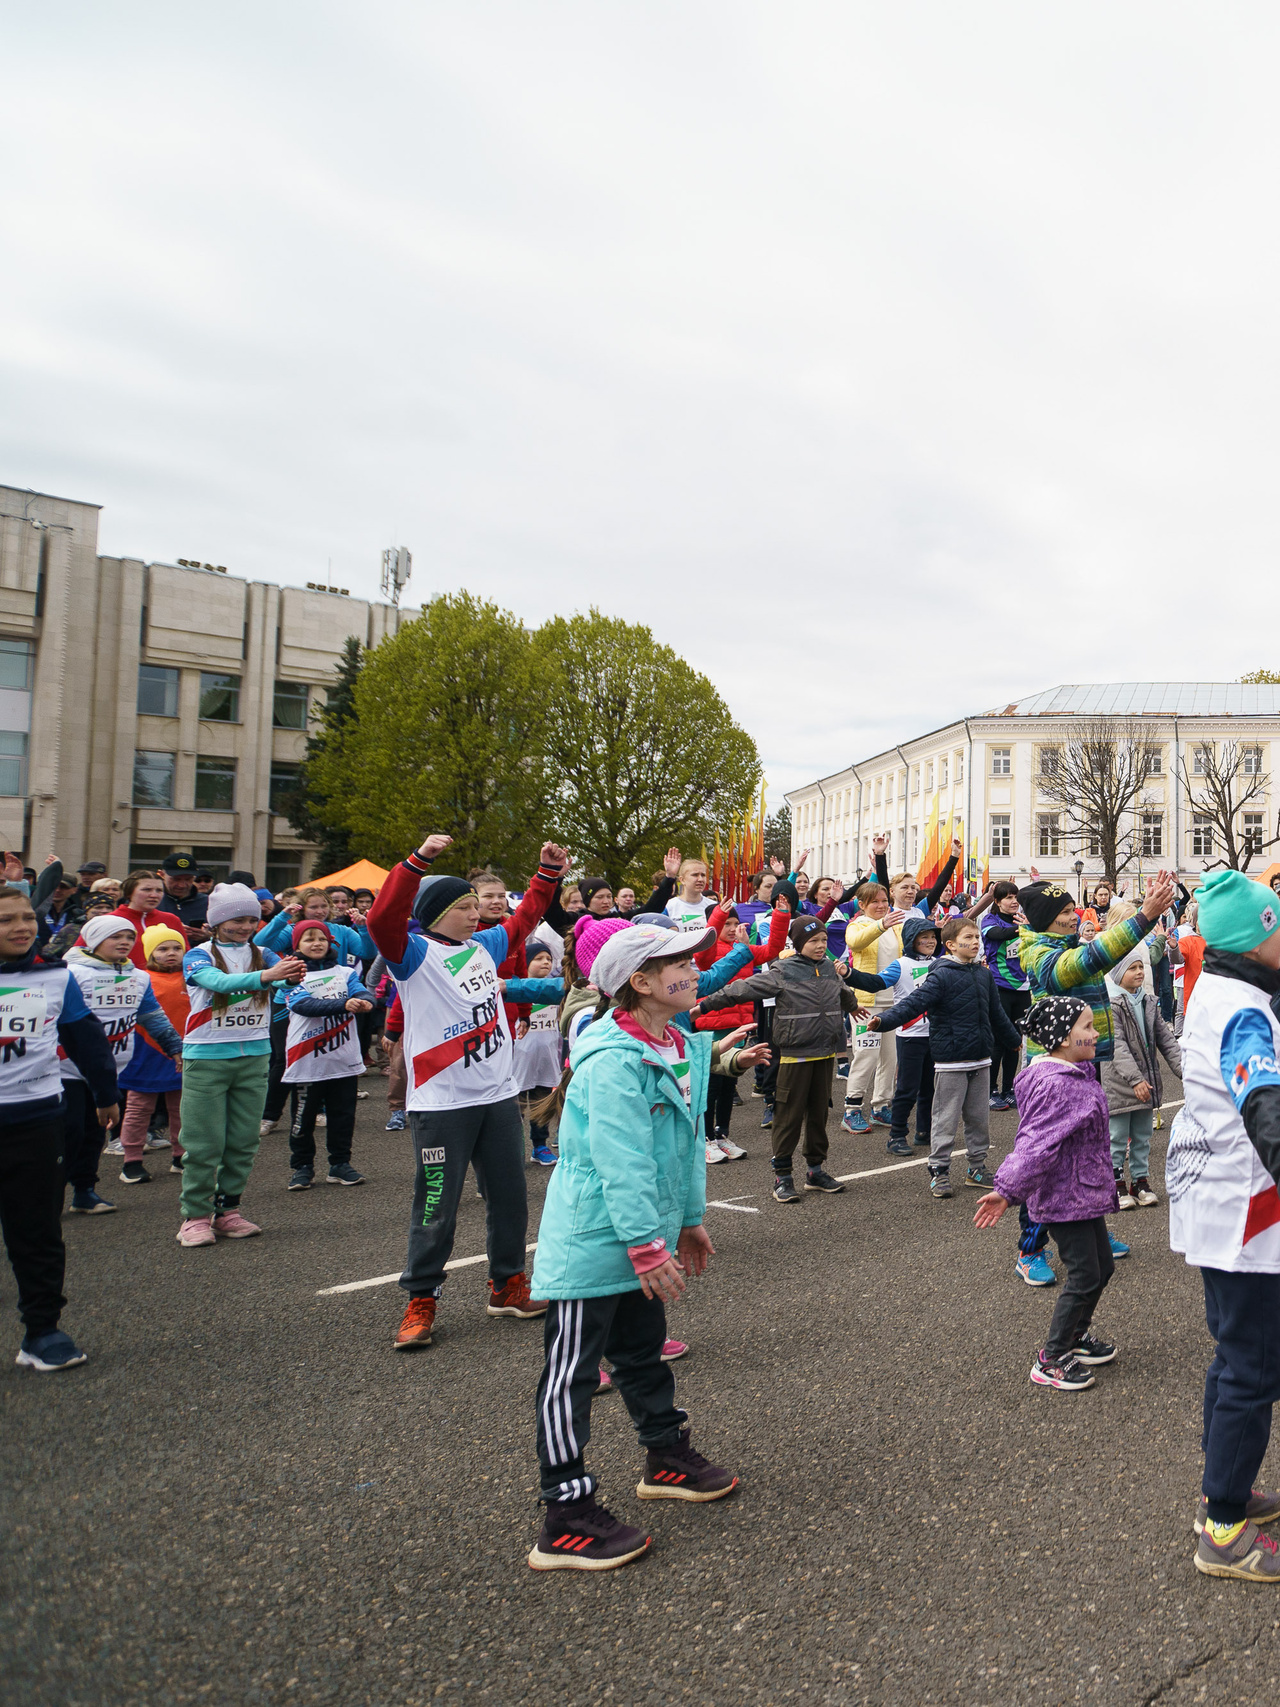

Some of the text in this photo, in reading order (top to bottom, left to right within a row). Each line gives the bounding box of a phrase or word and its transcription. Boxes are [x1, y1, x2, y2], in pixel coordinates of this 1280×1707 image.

[460, 970, 494, 994] 15162
[96, 994, 137, 1006] 15187
[214, 1014, 264, 1028] 15067
[314, 1025, 350, 1058] RUN
[423, 1149, 444, 1162] NYC
